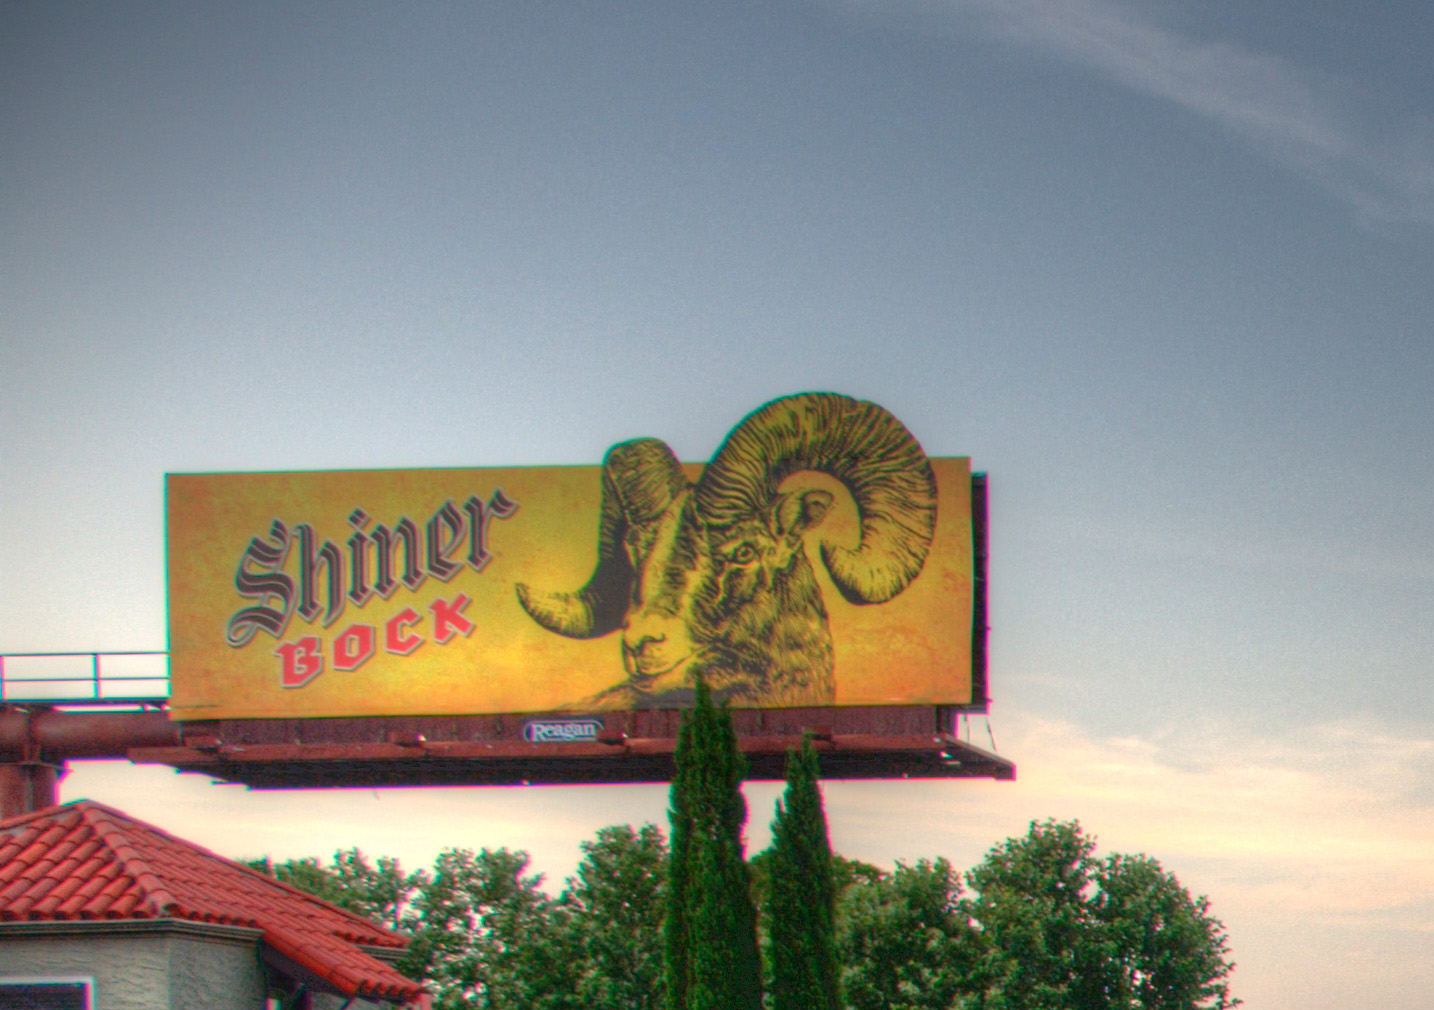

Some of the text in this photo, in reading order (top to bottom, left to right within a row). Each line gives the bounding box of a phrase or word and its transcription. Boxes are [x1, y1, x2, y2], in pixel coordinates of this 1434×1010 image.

[227, 487, 519, 647] Shiner
[273, 592, 476, 688] BOCK
[531, 722, 598, 742] Reagan
